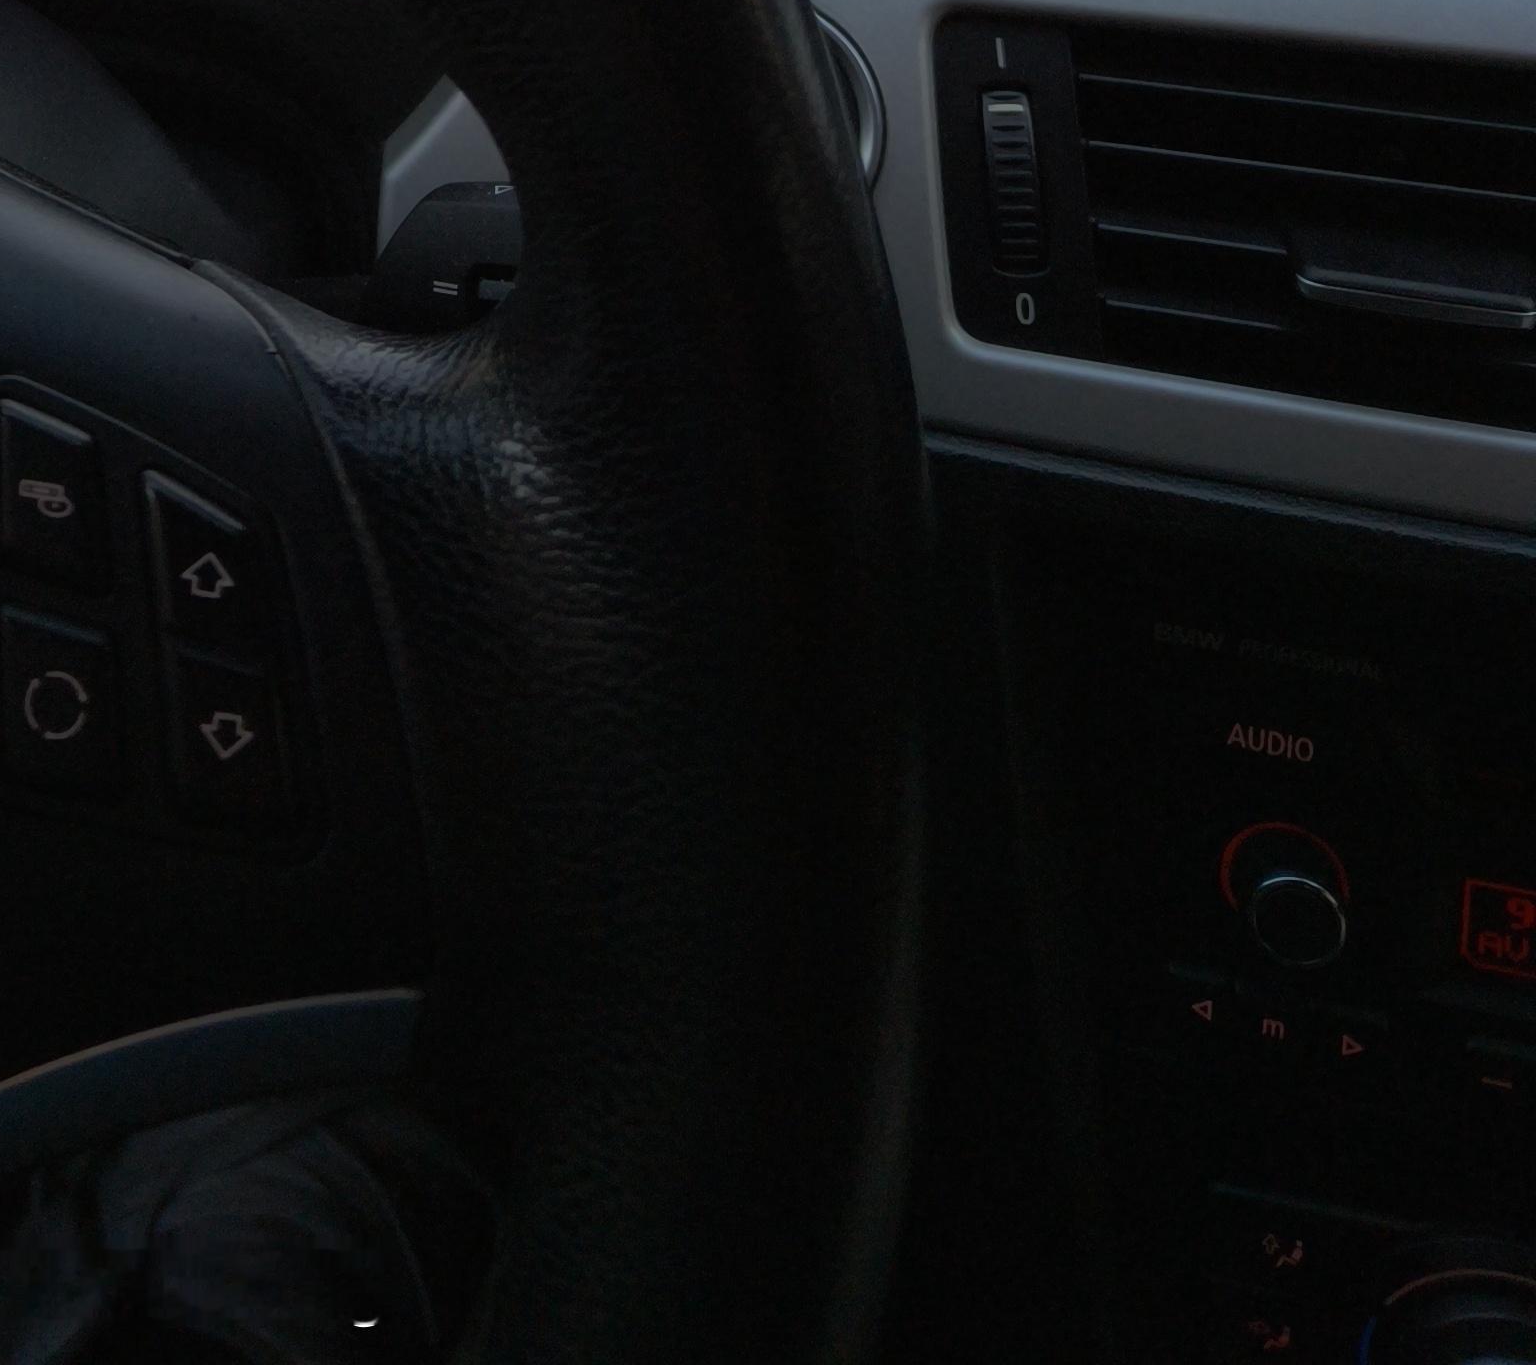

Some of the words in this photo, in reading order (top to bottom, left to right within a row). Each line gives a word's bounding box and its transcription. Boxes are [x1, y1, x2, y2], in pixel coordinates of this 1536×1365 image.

[1016, 291, 1035, 326] 0
[1225, 723, 1315, 762] AUDIO
[1261, 1016, 1286, 1041] m
